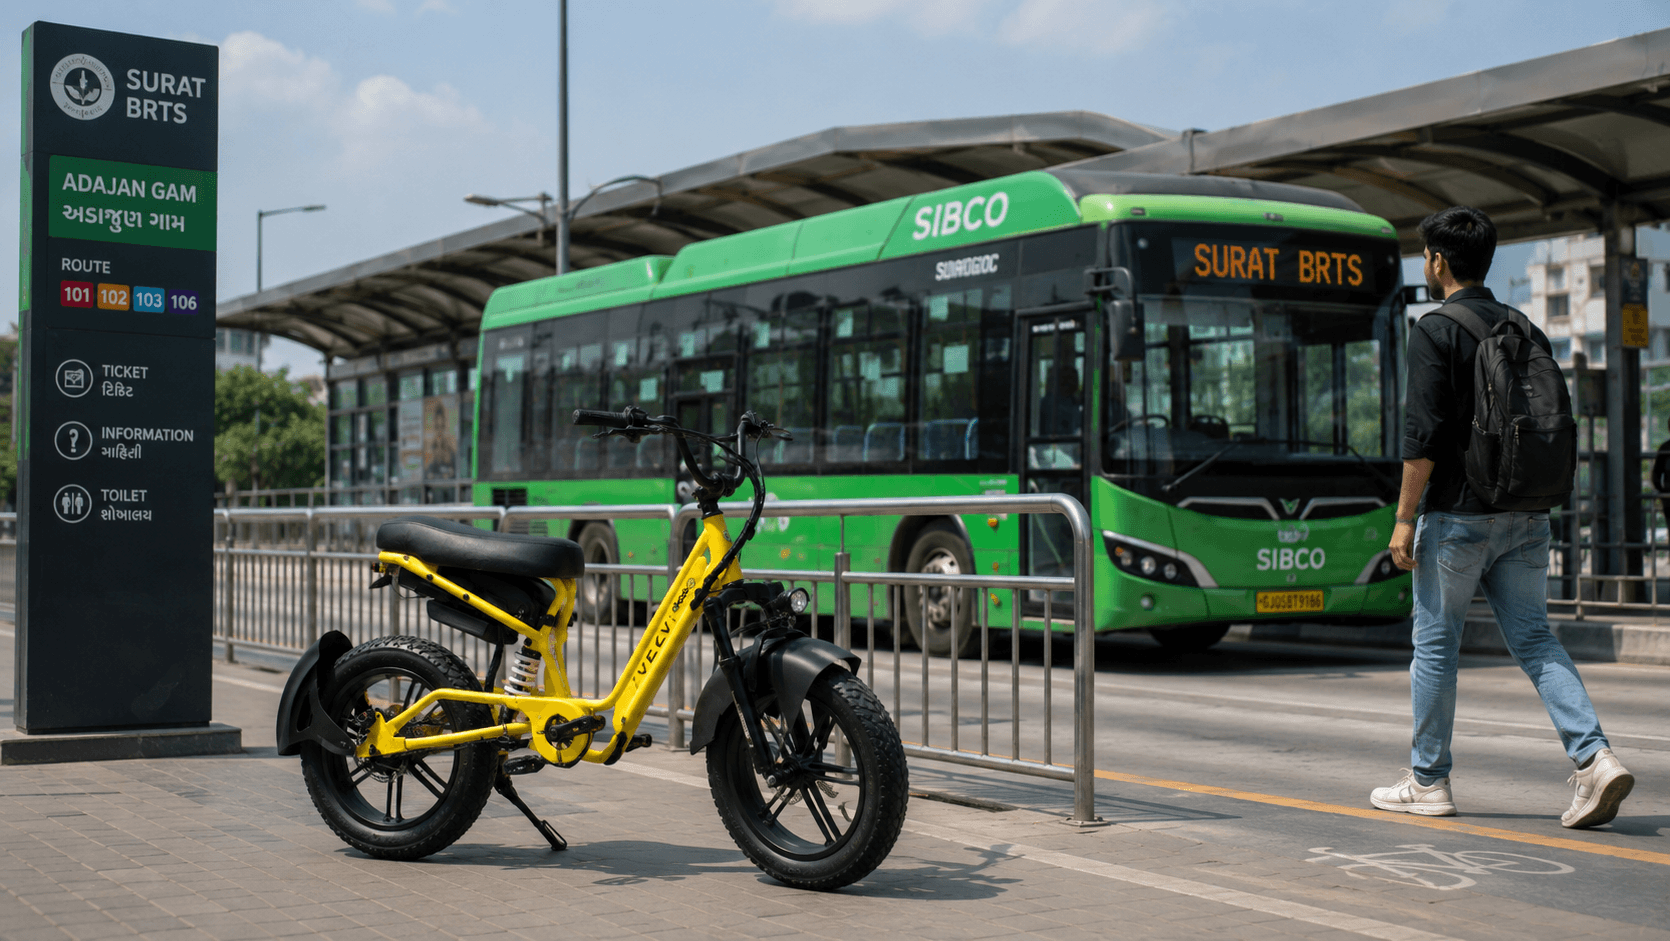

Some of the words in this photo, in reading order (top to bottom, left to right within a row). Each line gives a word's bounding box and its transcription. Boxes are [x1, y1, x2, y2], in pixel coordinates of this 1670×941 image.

[126, 68, 206, 98] SURAT
[126, 96, 187, 124] BRTS
[62, 172, 146, 198] ADAJAN
[151, 181, 197, 203] GAM
[149, 212, 185, 232] ગામ
[912, 191, 1009, 241] SIBCO
[61, 257, 111, 274] ROUTE
[1194, 243, 1279, 280] SURAT
[1299, 250, 1363, 286] BRTS
[64, 286, 89, 302] 101
[100, 289, 127, 305] 102
[136, 292, 162, 308] 103
[171, 294, 197, 310] 106
[102, 364, 149, 379] TICKET
[101, 426, 194, 442] INFORMATION
[100, 488, 148, 502] TOILET
[1256, 547, 1325, 570] SIBCO
